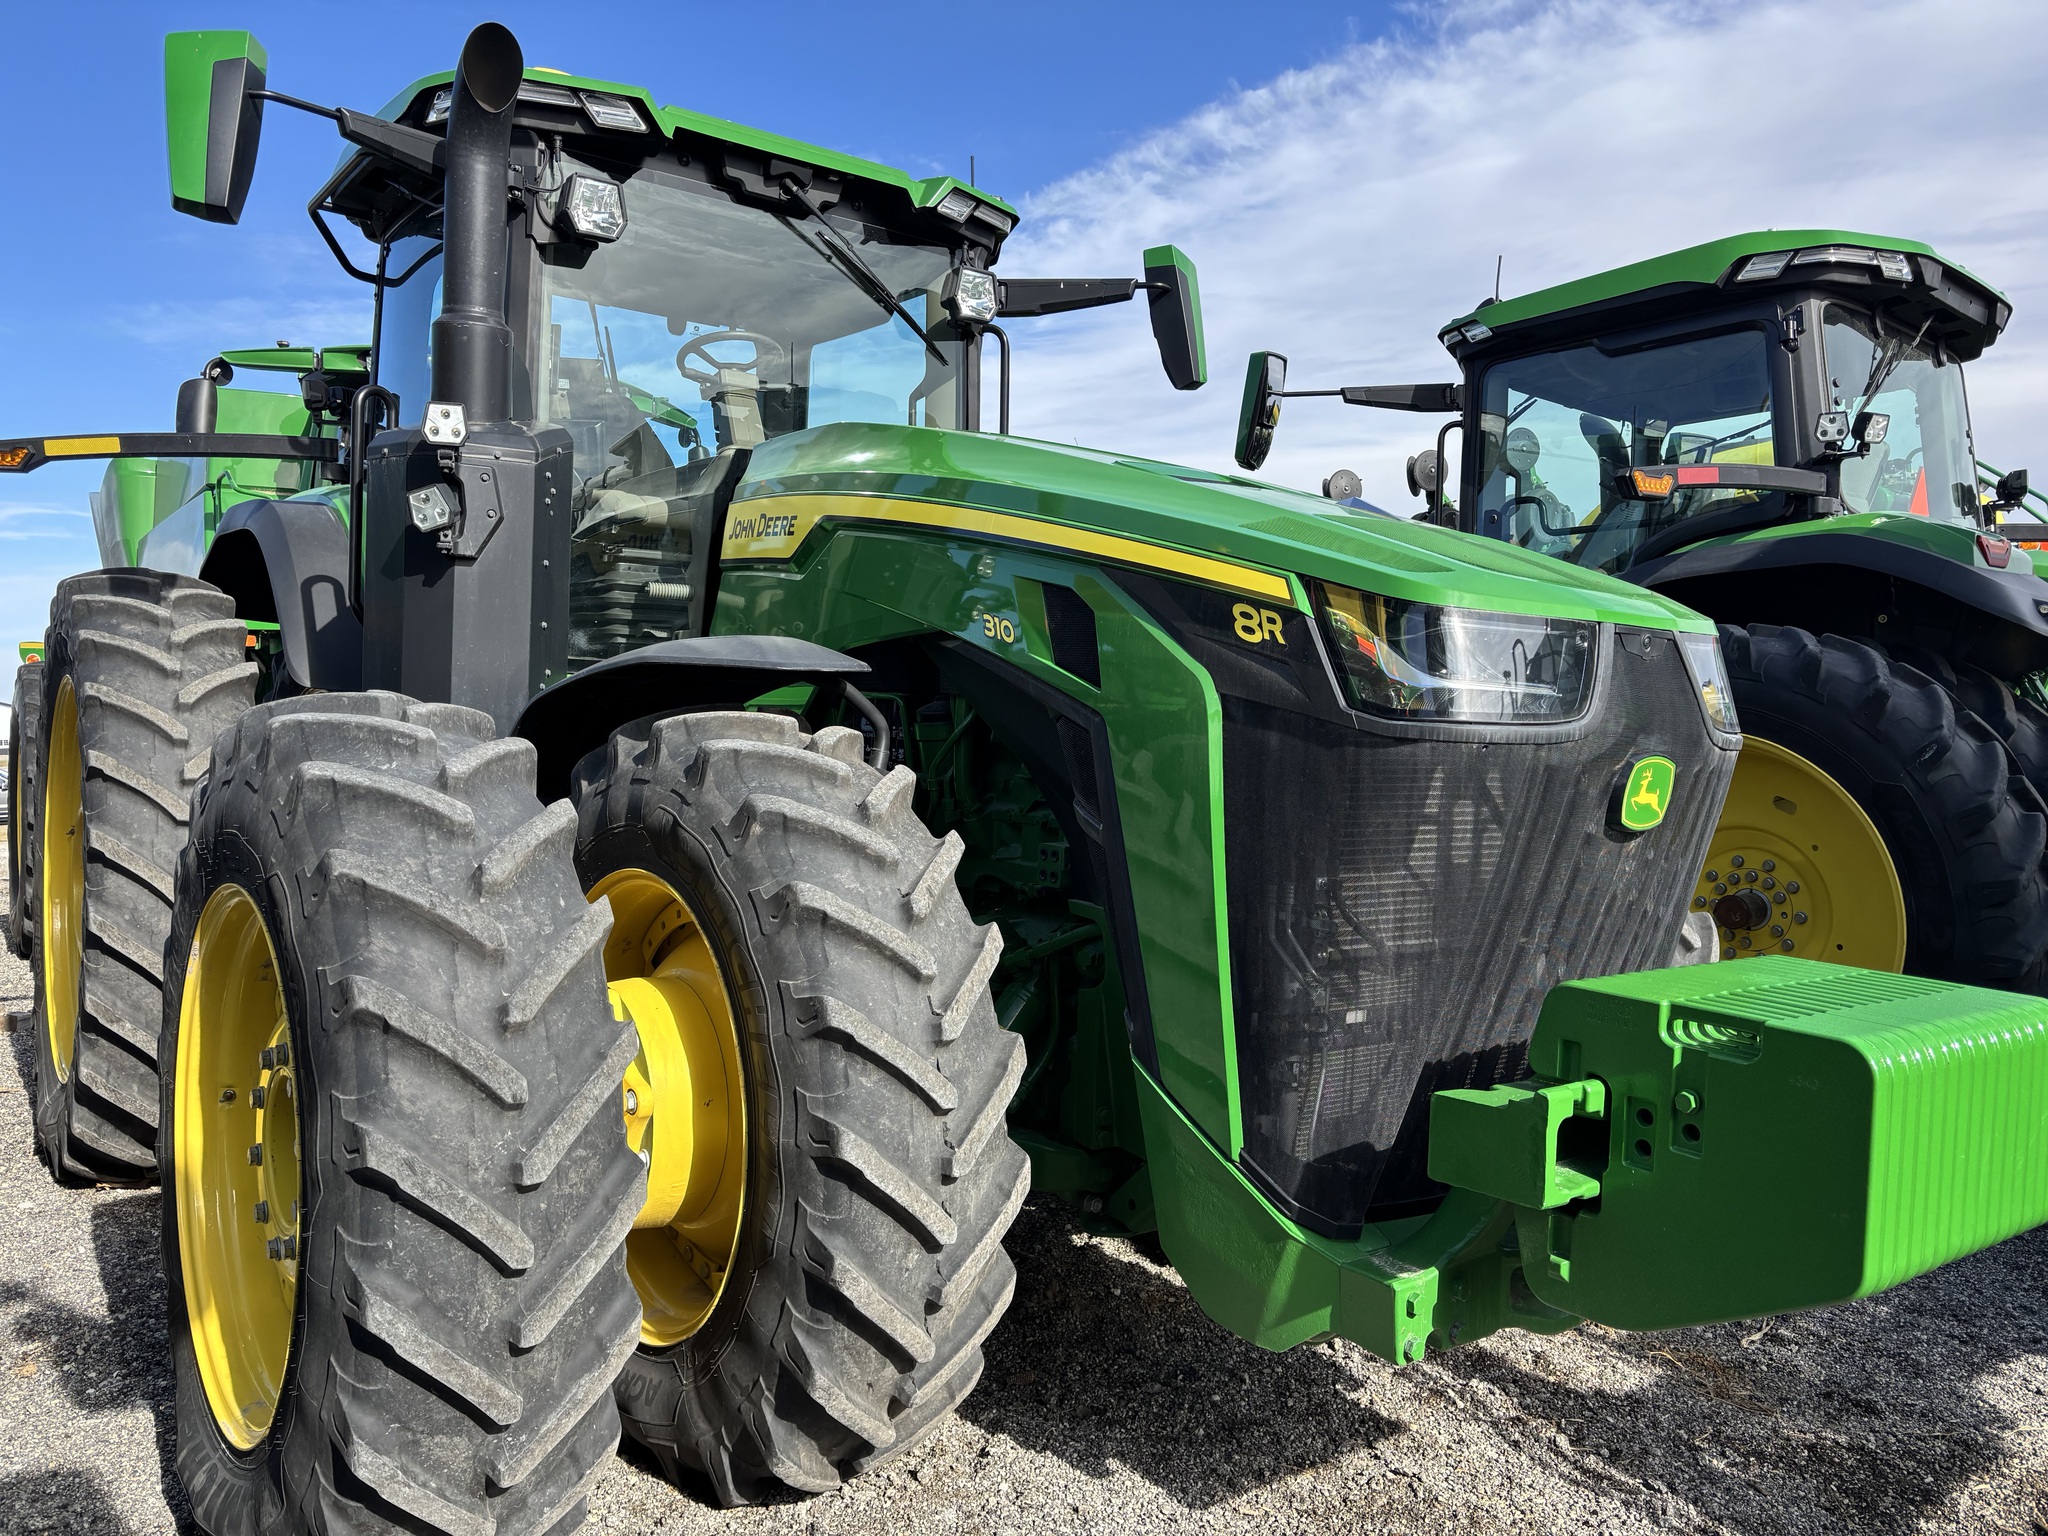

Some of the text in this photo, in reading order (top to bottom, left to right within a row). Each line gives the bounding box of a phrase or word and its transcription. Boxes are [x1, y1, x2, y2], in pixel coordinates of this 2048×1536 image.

[729, 513, 798, 540] JOHN DEERE
[982, 612, 1015, 645] 310
[1232, 603, 1286, 645] 8R
